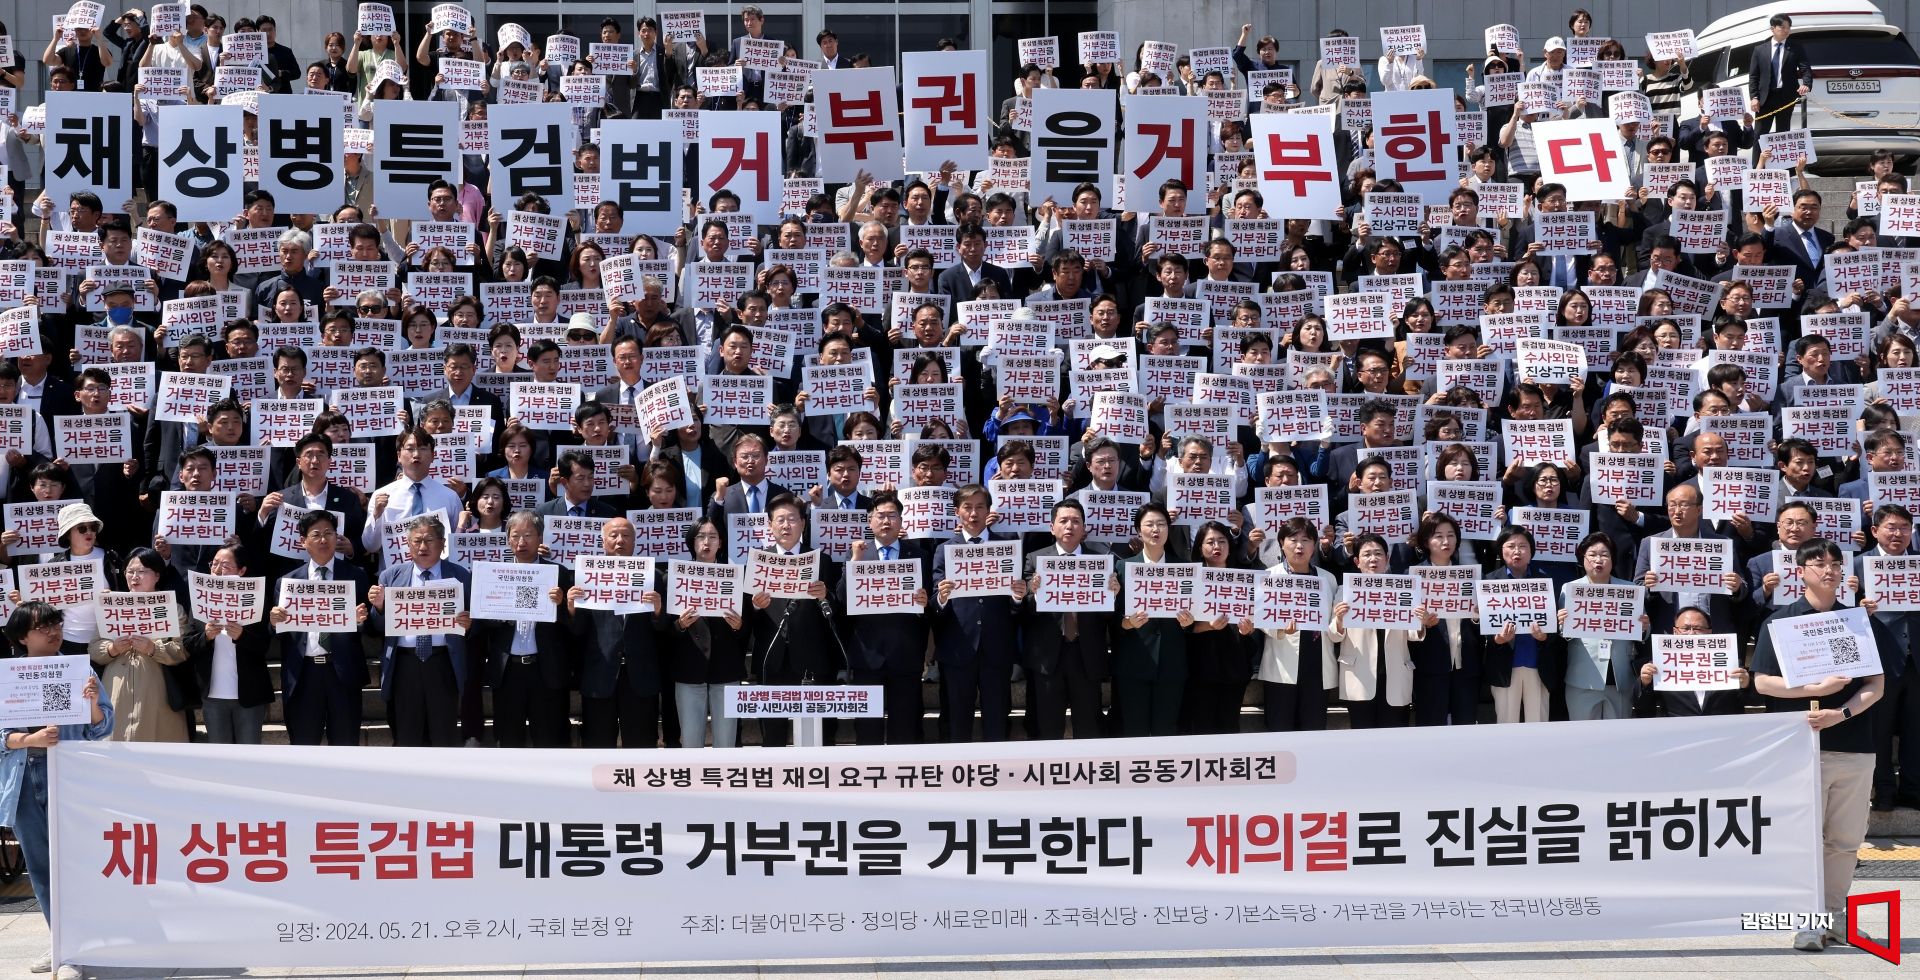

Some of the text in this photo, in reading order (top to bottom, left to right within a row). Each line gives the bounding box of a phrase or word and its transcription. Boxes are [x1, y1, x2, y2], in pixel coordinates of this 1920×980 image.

[1084, 40, 1116, 50] 거부권을
[1084, 51, 1117, 60] 거부한다
[912, 73, 978, 146] 권
[824, 90, 894, 160] 부
[52, 115, 122, 190] 채
[380, 123, 452, 184] 특
[1038, 112, 1108, 183] 을
[1380, 110, 1450, 182] 한
[269, 118, 334, 190] 병
[499, 125, 562, 196] 검
[1133, 118, 1194, 190] 거
[1548, 132, 1617, 182] 다
[163, 126, 237, 198] 상
[708, 132, 770, 201] 거
[1264, 134, 1332, 197] 부
[611, 141, 672, 212] 법
[1369, 195, 1419, 204] 특검법 재의결로
[1371, 205, 1418, 218] 수사외압
[1543, 214, 1588, 222] 채 상병 특검법
[1370, 219, 1418, 231] 진상규명
[1542, 224, 1589, 236] 거부권을
[1542, 238, 1590, 250] 거부한다
[1332, 294, 1384, 306] 채 상병 특검법
[1332, 306, 1384, 320] 거부권을
[1333, 320, 1386, 334] 거부한다
[519, 385, 572, 394] 채 상병 특검법
[712, 378, 764, 388] 채 상병 특검법
[518, 396, 572, 409] 거부권을
[711, 389, 764, 404] 거부권을
[518, 411, 573, 424] 거부한다
[711, 405, 766, 420] 거부한다
[64, 417, 122, 428] 채 상병 특검법
[64, 430, 122, 444] 거부권을
[64, 444, 124, 459] 거부한다
[1598, 456, 1655, 467] 채 상병 특검법
[1598, 469, 1655, 484] 거부권을
[1598, 485, 1655, 500] 거부한다
[1661, 542, 1722, 553] 채 상병 특검법
[1046, 560, 1104, 570] 채 상병 특검법
[1660, 554, 1724, 571] 거부권을
[678, 564, 735, 578] 채 상병 특검법
[676, 578, 735, 594] 거부권을
[1046, 574, 1105, 588] 거부권을
[1353, 578, 1412, 589] 채 상병 특검법
[1482, 582, 1548, 593] 특검법 재의결로
[1659, 572, 1725, 588] 거부한다
[104, 594, 166, 605] 채 상병 특검법
[675, 594, 735, 610] 거부한다
[1046, 590, 1106, 605] 거부한다
[1352, 591, 1413, 606] 거부권을
[1486, 595, 1546, 610] 수사외압
[104, 606, 168, 622] 거부권을
[1352, 608, 1414, 623] 거부한다
[106, 620, 172, 637] 거부한다
[1662, 638, 1727, 650] 채 상병 특검법
[1662, 652, 1728, 667] 거부권을
[1662, 670, 1730, 684] 거부한다
[738, 690, 868, 701] 채 상병 특검법 재의 요구 규탄
[737, 702, 868, 713] 야당·시민사회 공동기자회견
[613, 757, 1277, 789] 채 상병 특검법 재의 요구 규탄 야당 시민사회 공동기자회견
[101, 794, 1772, 887] 채 상병 특검법 대통령 거부권을 거부한다 재의결로 진실을 밝히자
[680, 896, 1602, 936] 주최: 더불어민주당 정의당 새로운미래 조국혁신당 진보당 기본소득당 거부권을 거부하는 전국비상행동
[276, 915, 634, 944] 일정: 2024. 05. 21. 오후 2시, 국회 본청 앞
